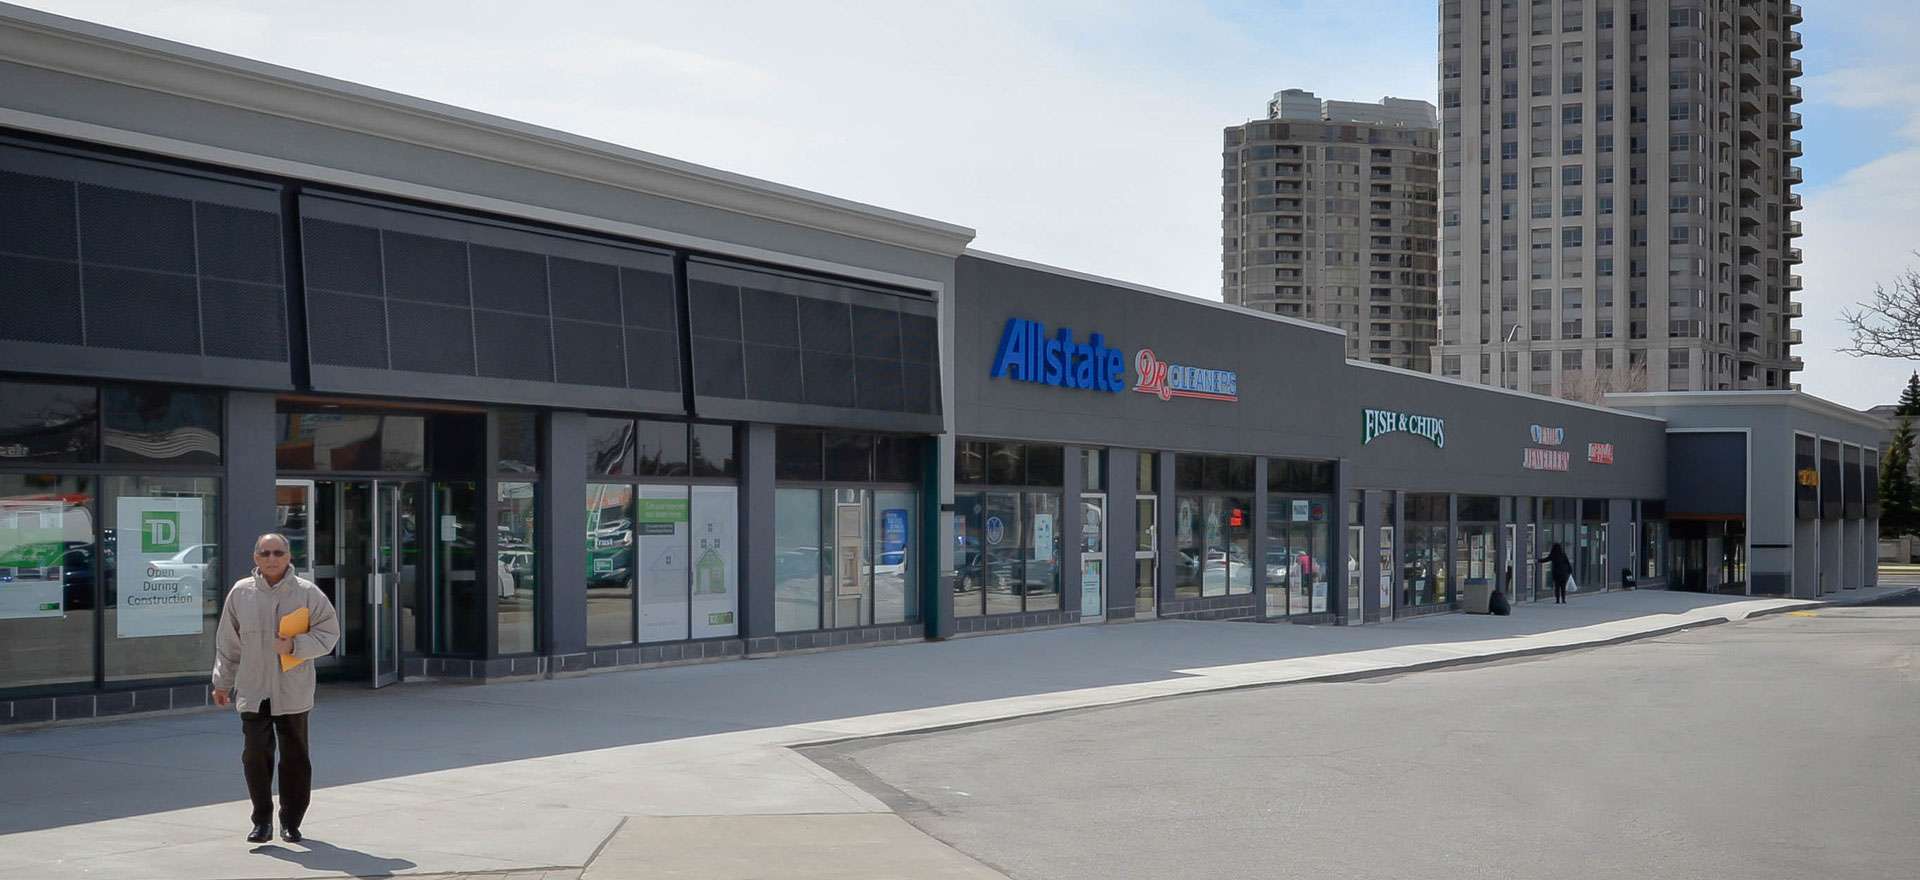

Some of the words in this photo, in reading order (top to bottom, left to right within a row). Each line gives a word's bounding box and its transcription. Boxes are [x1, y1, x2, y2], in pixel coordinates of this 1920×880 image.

[990, 318, 1125, 392] Allstate
[1168, 365, 1237, 395] CLEANERS
[1363, 408, 1397, 444] FISH
[1398, 413, 1408, 432] &
[1409, 414, 1444, 448] CHIPS
[144, 518, 177, 546] TD
[143, 581, 179, 592] During
[146, 567, 175, 579] Open
[127, 593, 193, 606] Construction
